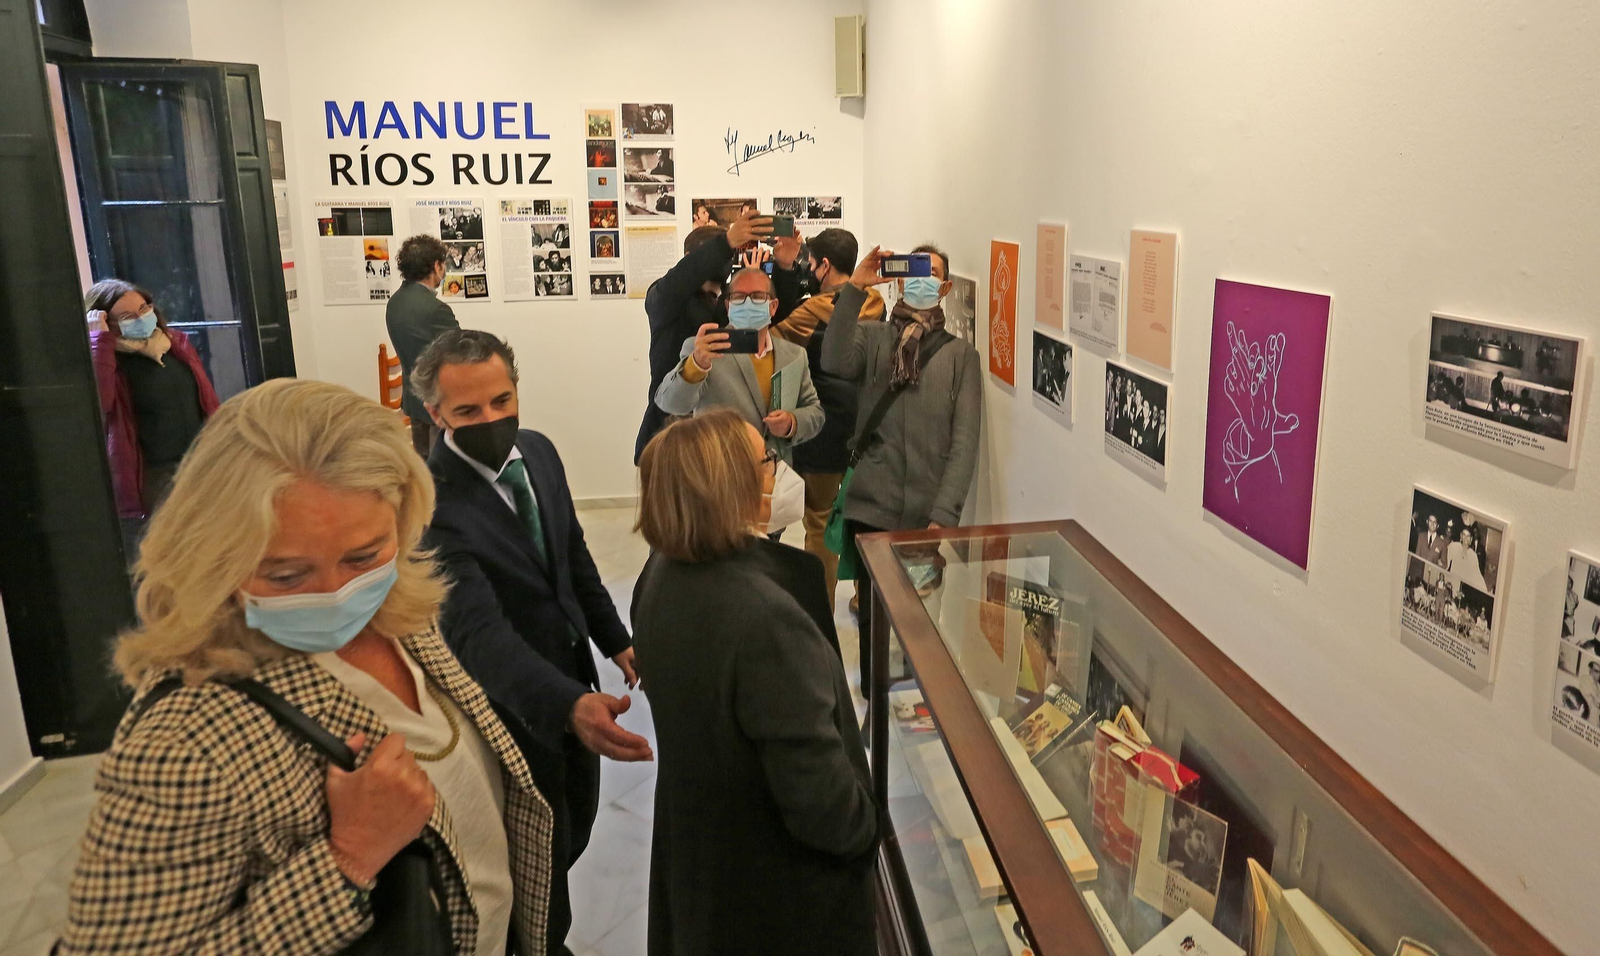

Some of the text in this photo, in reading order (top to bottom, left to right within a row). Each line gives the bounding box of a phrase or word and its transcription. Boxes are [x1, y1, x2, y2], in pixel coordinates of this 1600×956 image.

[324, 100, 551, 140] MANUEL
[329, 144, 553, 186] RÍOS RUIZ
[1010, 587, 1060, 611] JEREZ
